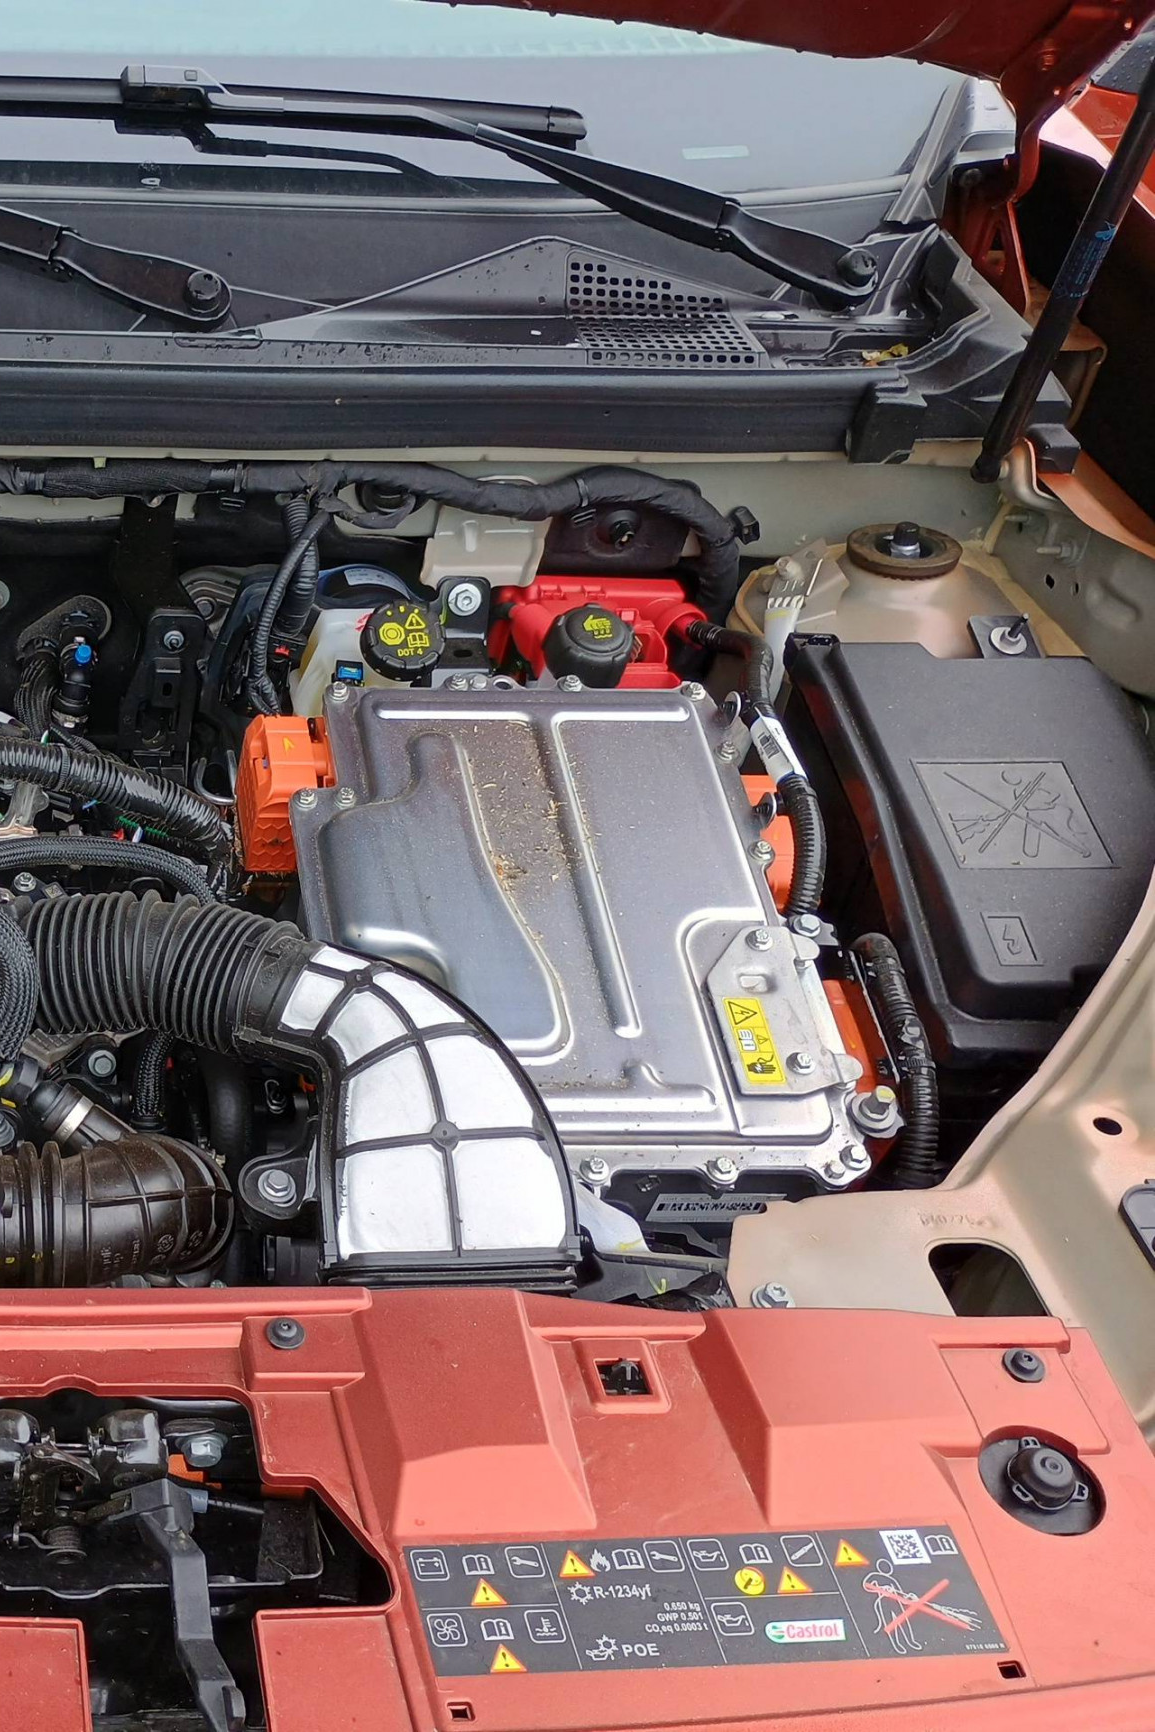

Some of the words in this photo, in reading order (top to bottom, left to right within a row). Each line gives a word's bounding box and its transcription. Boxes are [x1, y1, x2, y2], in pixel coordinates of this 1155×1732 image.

[593, 1584, 652, 1600] R-1234yf
[688, 1602, 701, 1612] kg
[657, 1613, 679, 1622] GWP
[680, 1612, 703, 1621] 0.501
[674, 1622, 702, 1632] 0.0003
[786, 1623, 840, 1639] Castrol
[397, 1648, 414, 1657] DOT
[621, 1643, 660, 1657] POE
